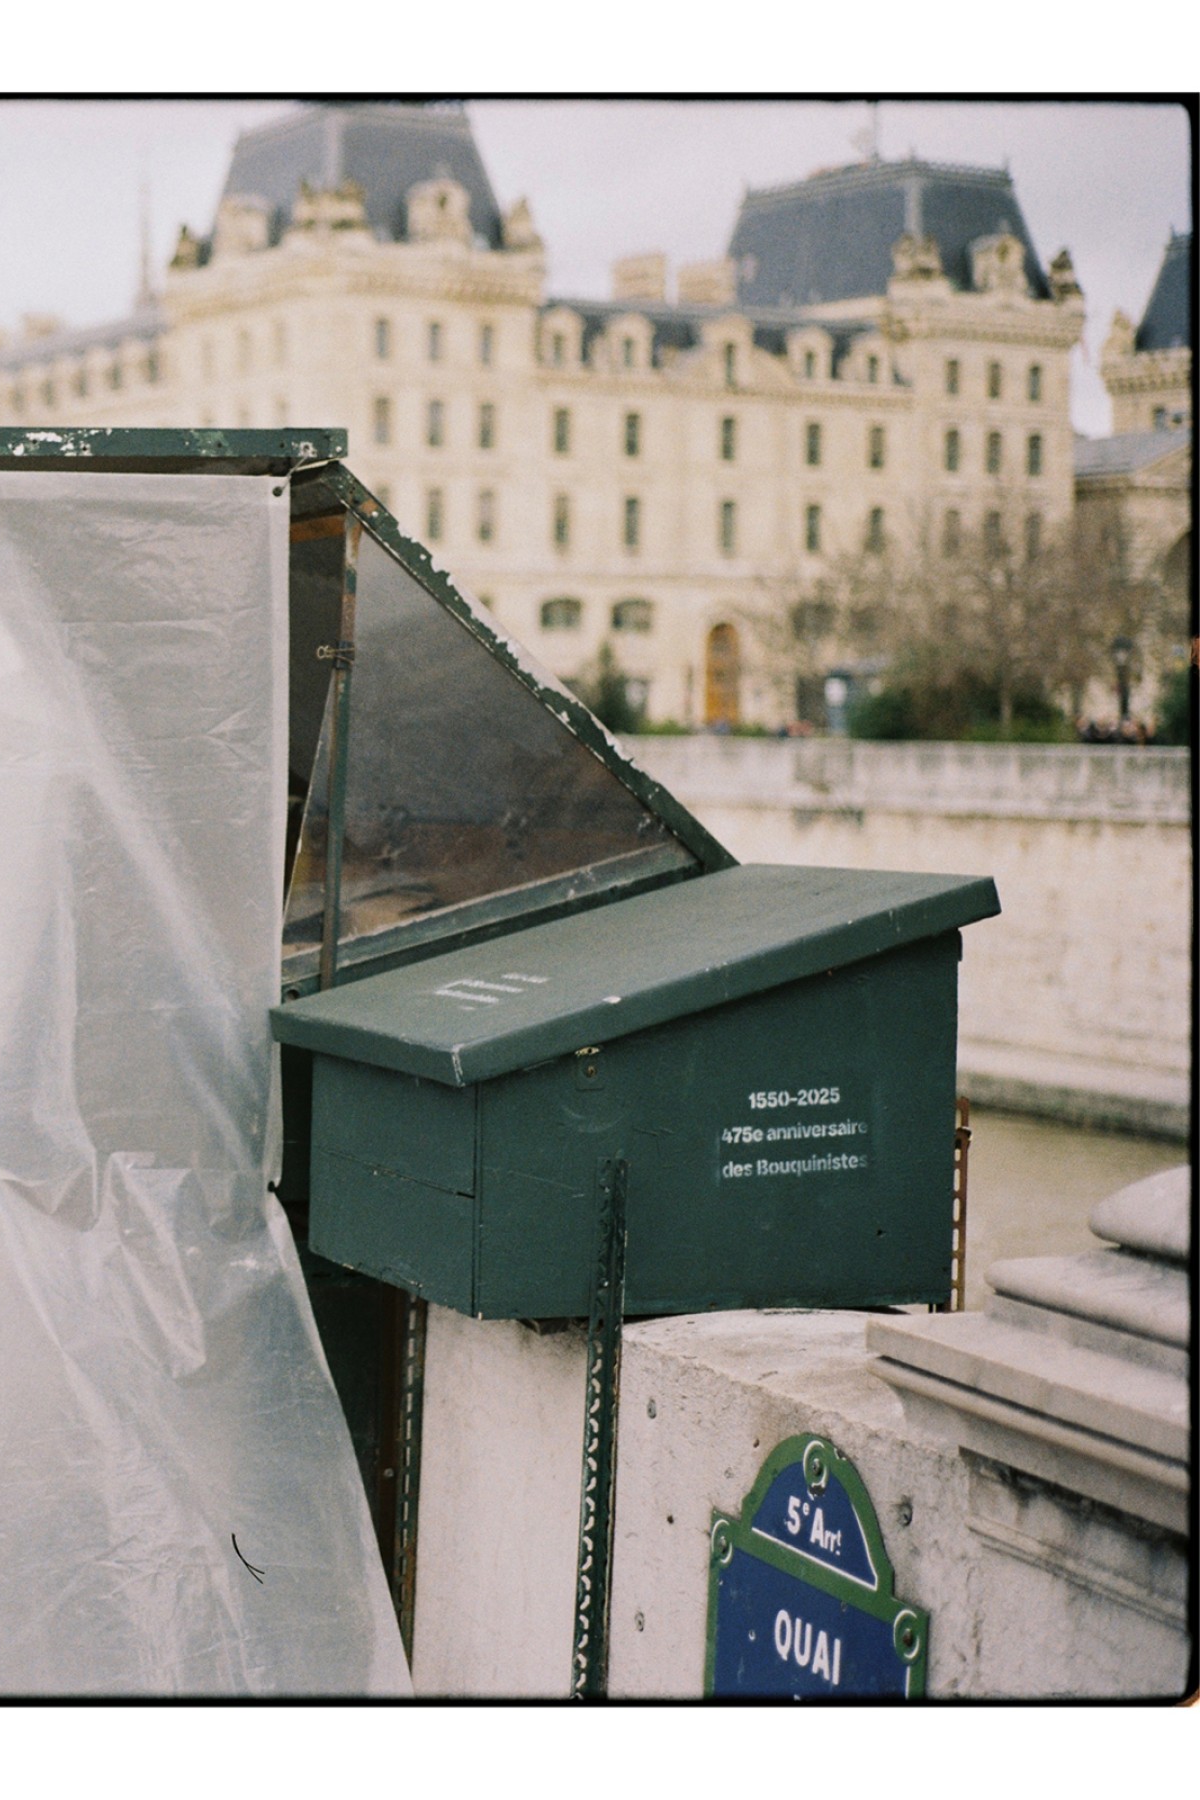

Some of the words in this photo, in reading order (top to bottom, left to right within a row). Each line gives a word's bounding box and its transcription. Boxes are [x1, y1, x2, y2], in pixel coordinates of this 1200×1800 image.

[748, 1087, 841, 1109] 1550-2025
[721, 1126, 764, 1144] 475e
[766, 1118, 868, 1141] anniversaire
[722, 1161, 753, 1178] des
[756, 1153, 867, 1177] Bouquinistes
[774, 1609, 842, 1686] QUAI
